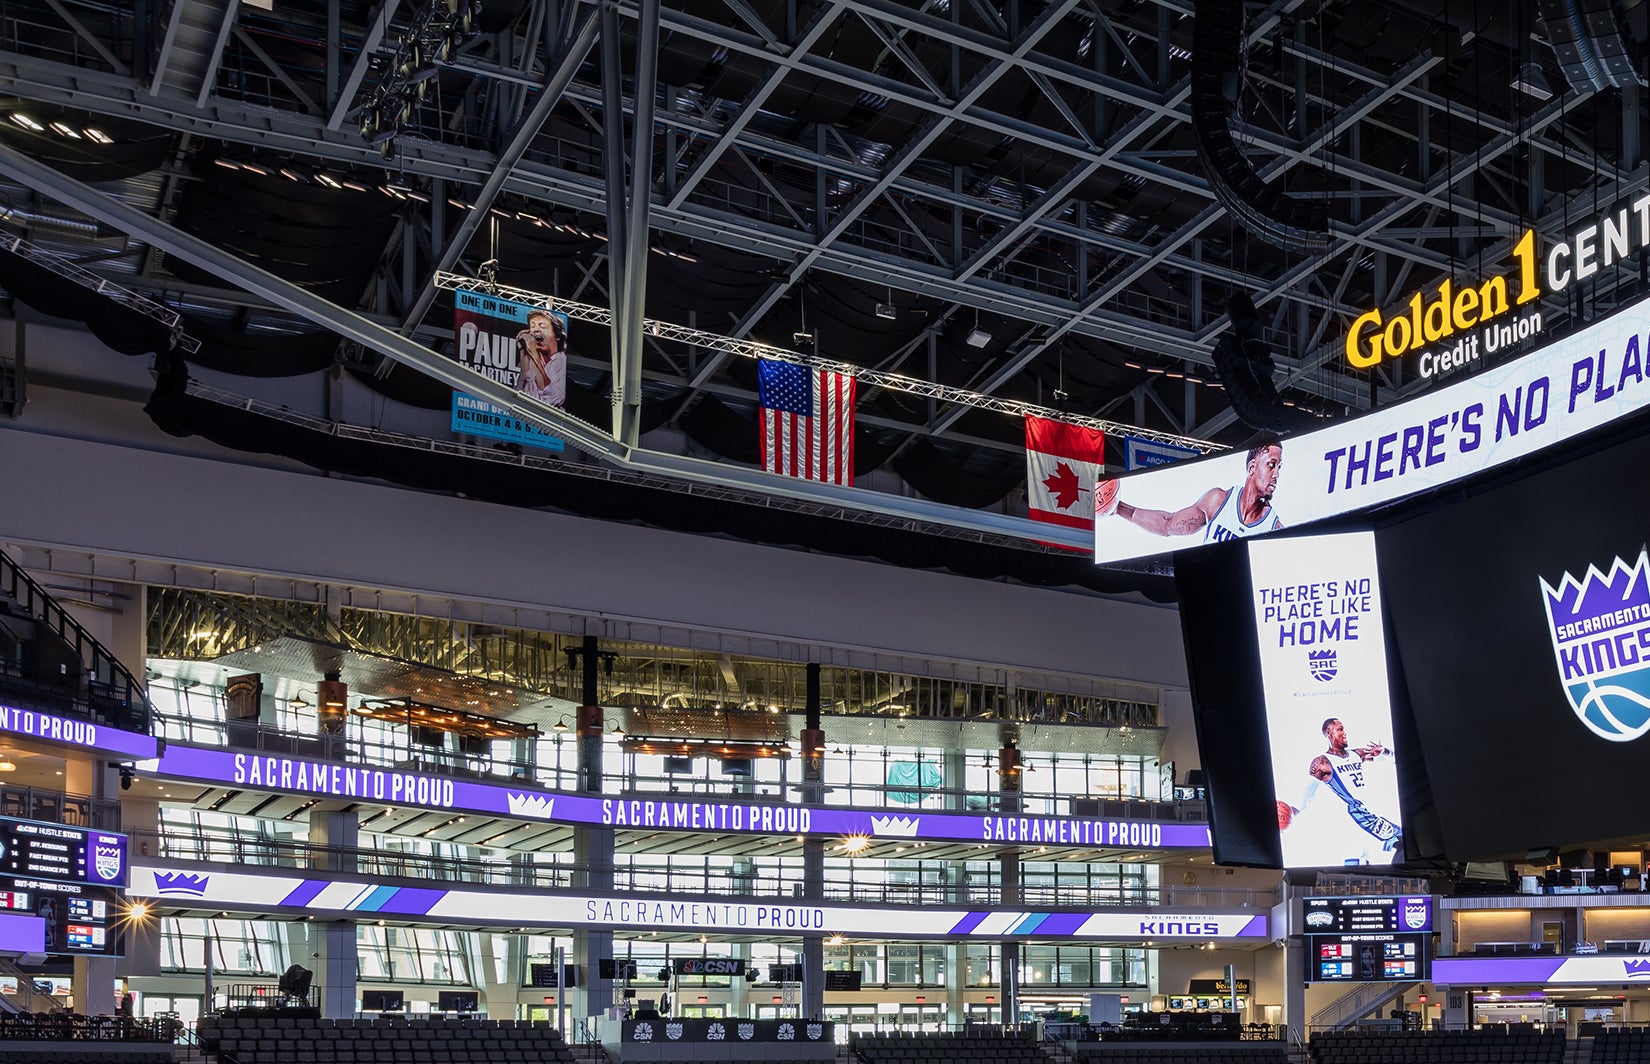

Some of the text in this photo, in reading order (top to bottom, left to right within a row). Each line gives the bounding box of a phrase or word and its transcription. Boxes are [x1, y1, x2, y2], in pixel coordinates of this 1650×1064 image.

[461, 294, 518, 316] ONE ON ONE
[1346, 278, 1509, 368] Golden
[459, 326, 521, 373] PAUL
[1419, 312, 1541, 378] Credit Union
[457, 409, 522, 431] OCTOBER 4 &
[1324, 403, 1484, 494] THERE'S
[1495, 377, 1551, 443] NO
[1259, 578, 1371, 604] THERE'S NO
[1264, 595, 1372, 623] PLACE LIKE
[1279, 616, 1359, 648] HOME
[1309, 659, 1338, 670] SAC
[40, 713, 97, 746] PROUD
[234, 753, 455, 807] SACRAMENTO PROUD
[602, 799, 811, 833] SACRAMENTO PROUD
[39, 827, 62, 837] HUSTLE
[983, 816, 1161, 847] SACRAMENTO PROUD
[57, 885, 82, 893] SCORES
[586, 900, 824, 929] SACRAMENTO PROUD
[1140, 922, 1219, 935] KINGS
[704, 961, 738, 973] CSN
[1450, 996, 1462, 1009] 103
[633, 1032, 653, 1040] CSN
[707, 1032, 725, 1040] CSN
[776, 1032, 795, 1040] CSN
